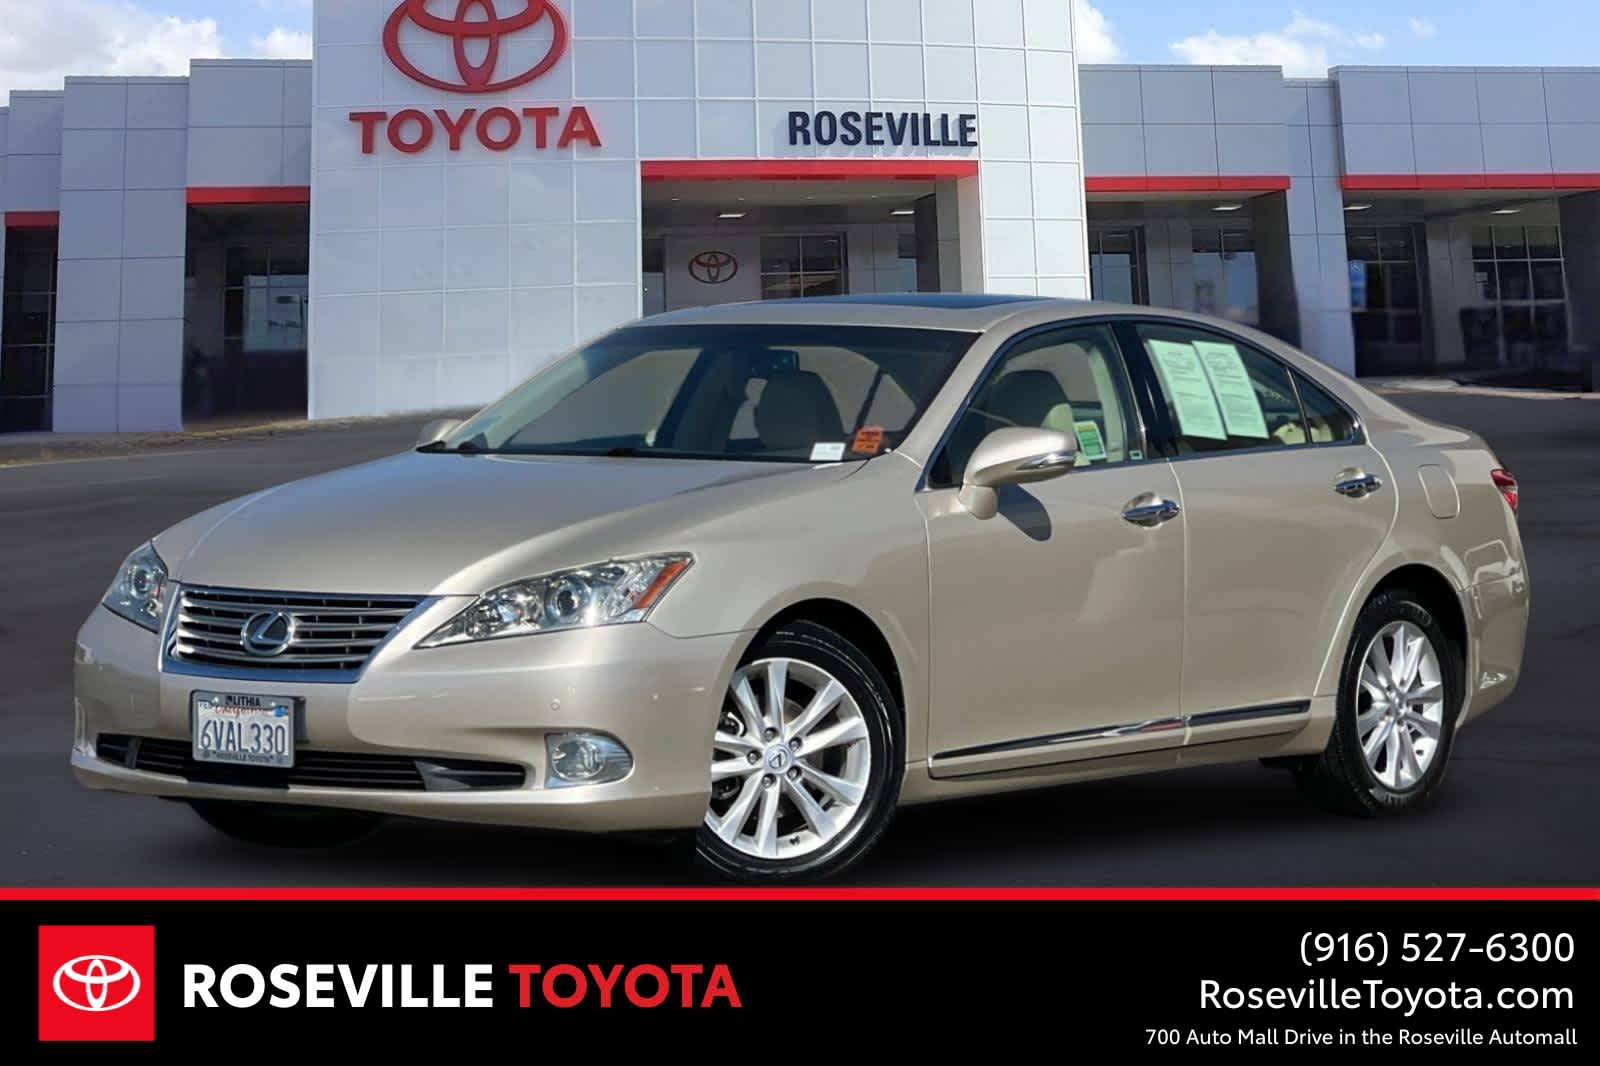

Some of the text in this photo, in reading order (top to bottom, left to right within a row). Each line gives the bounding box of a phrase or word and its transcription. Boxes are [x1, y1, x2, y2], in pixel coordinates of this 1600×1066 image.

[349, 106, 601, 154] TOYOTA
[788, 111, 978, 147] ROSEVILLE
[233, 696, 261, 706] LITHIA
[201, 719, 285, 754] 6VAL330
